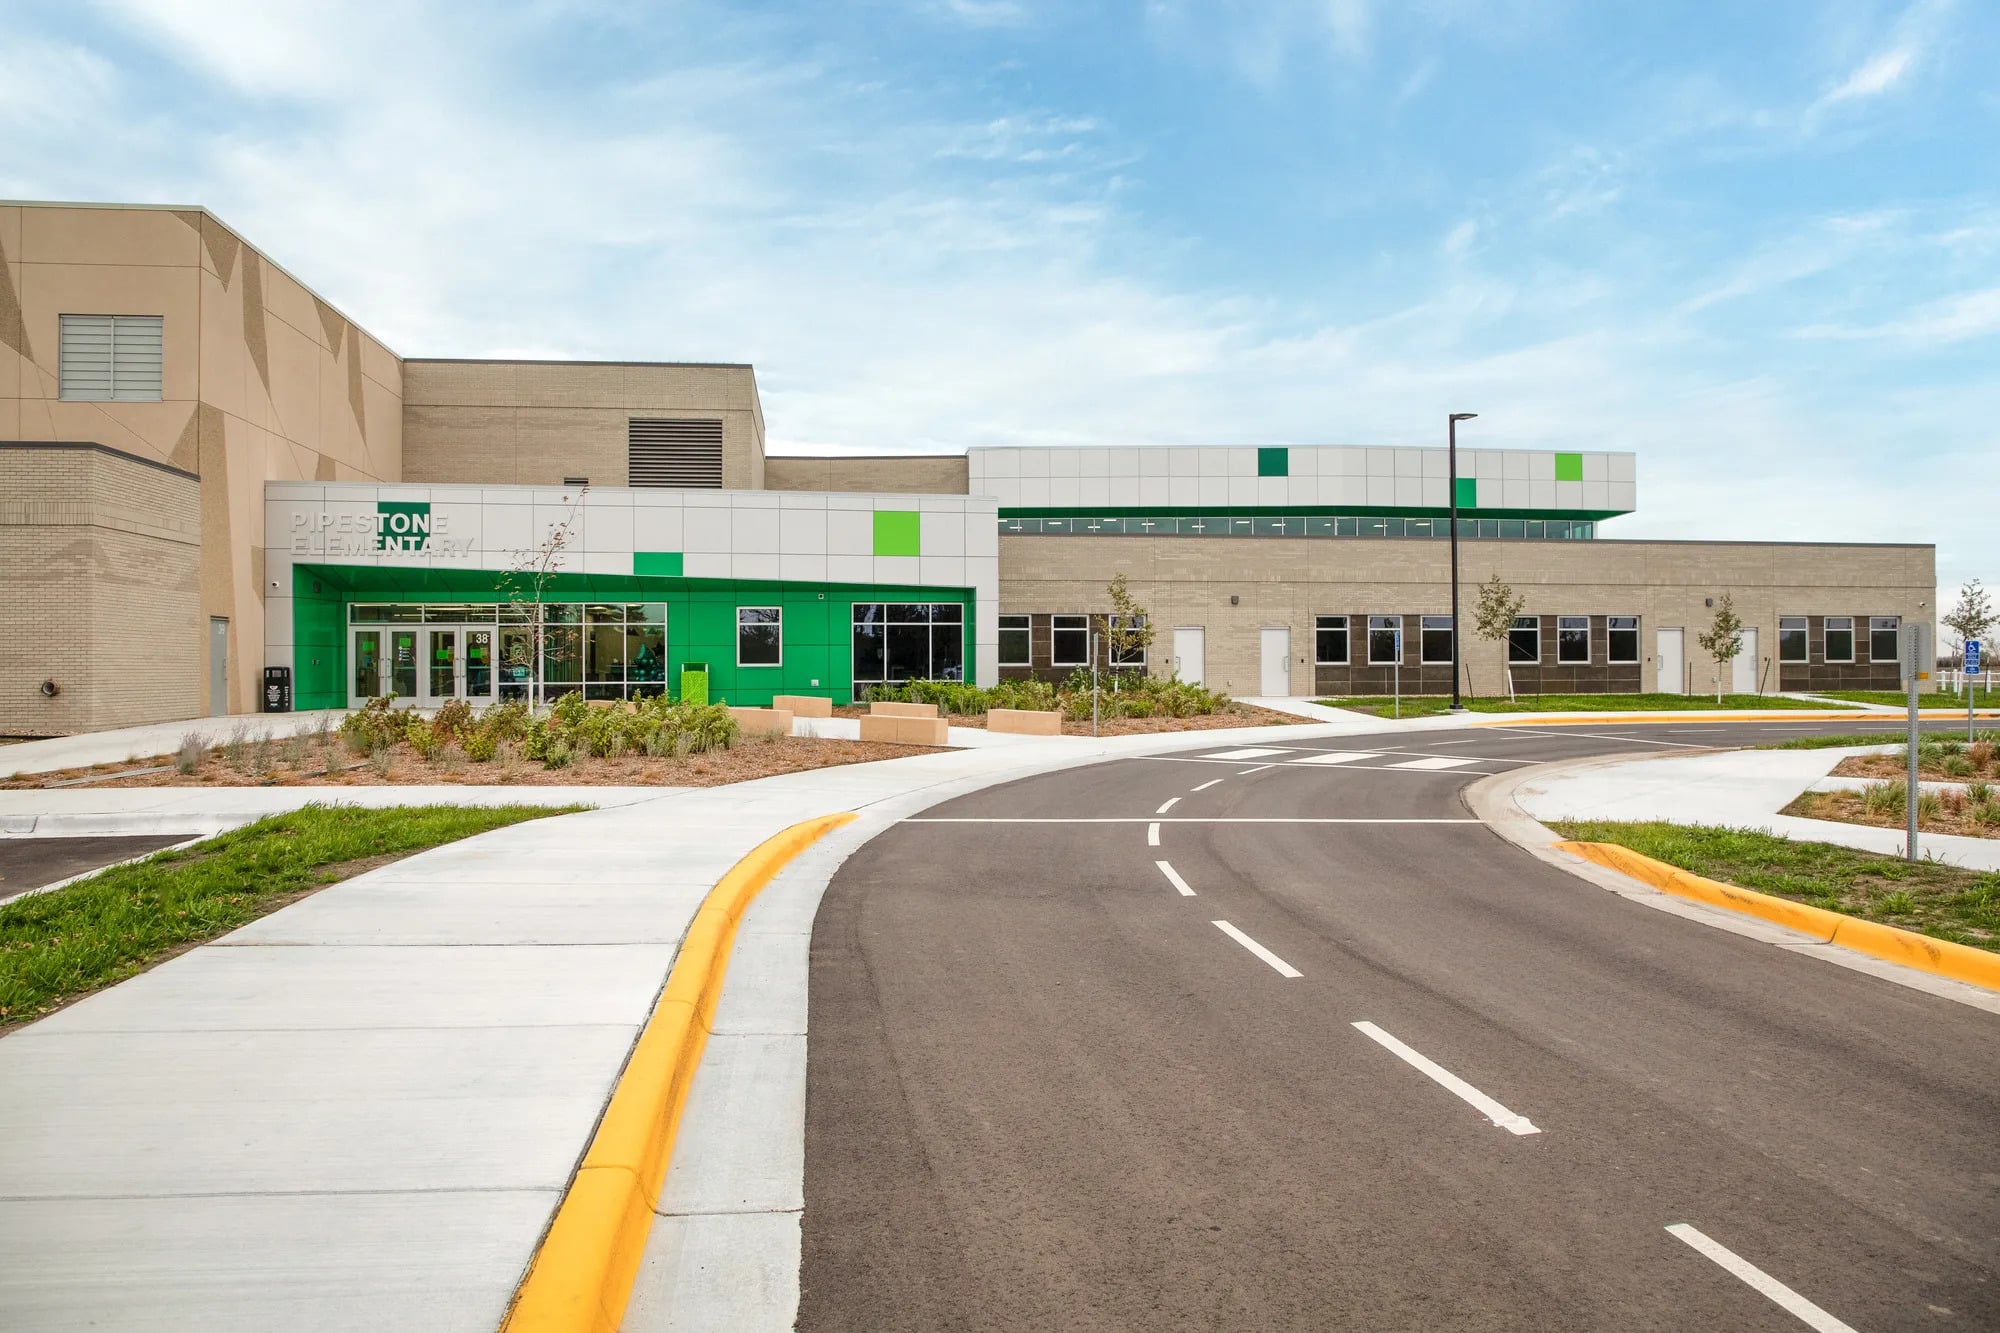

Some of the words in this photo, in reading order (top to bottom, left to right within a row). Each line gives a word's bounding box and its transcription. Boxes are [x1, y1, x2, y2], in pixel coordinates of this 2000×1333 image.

[290, 511, 449, 534] PIPESTONE
[290, 535, 474, 557] ELEMENTARY
[475, 633, 488, 644] 38
